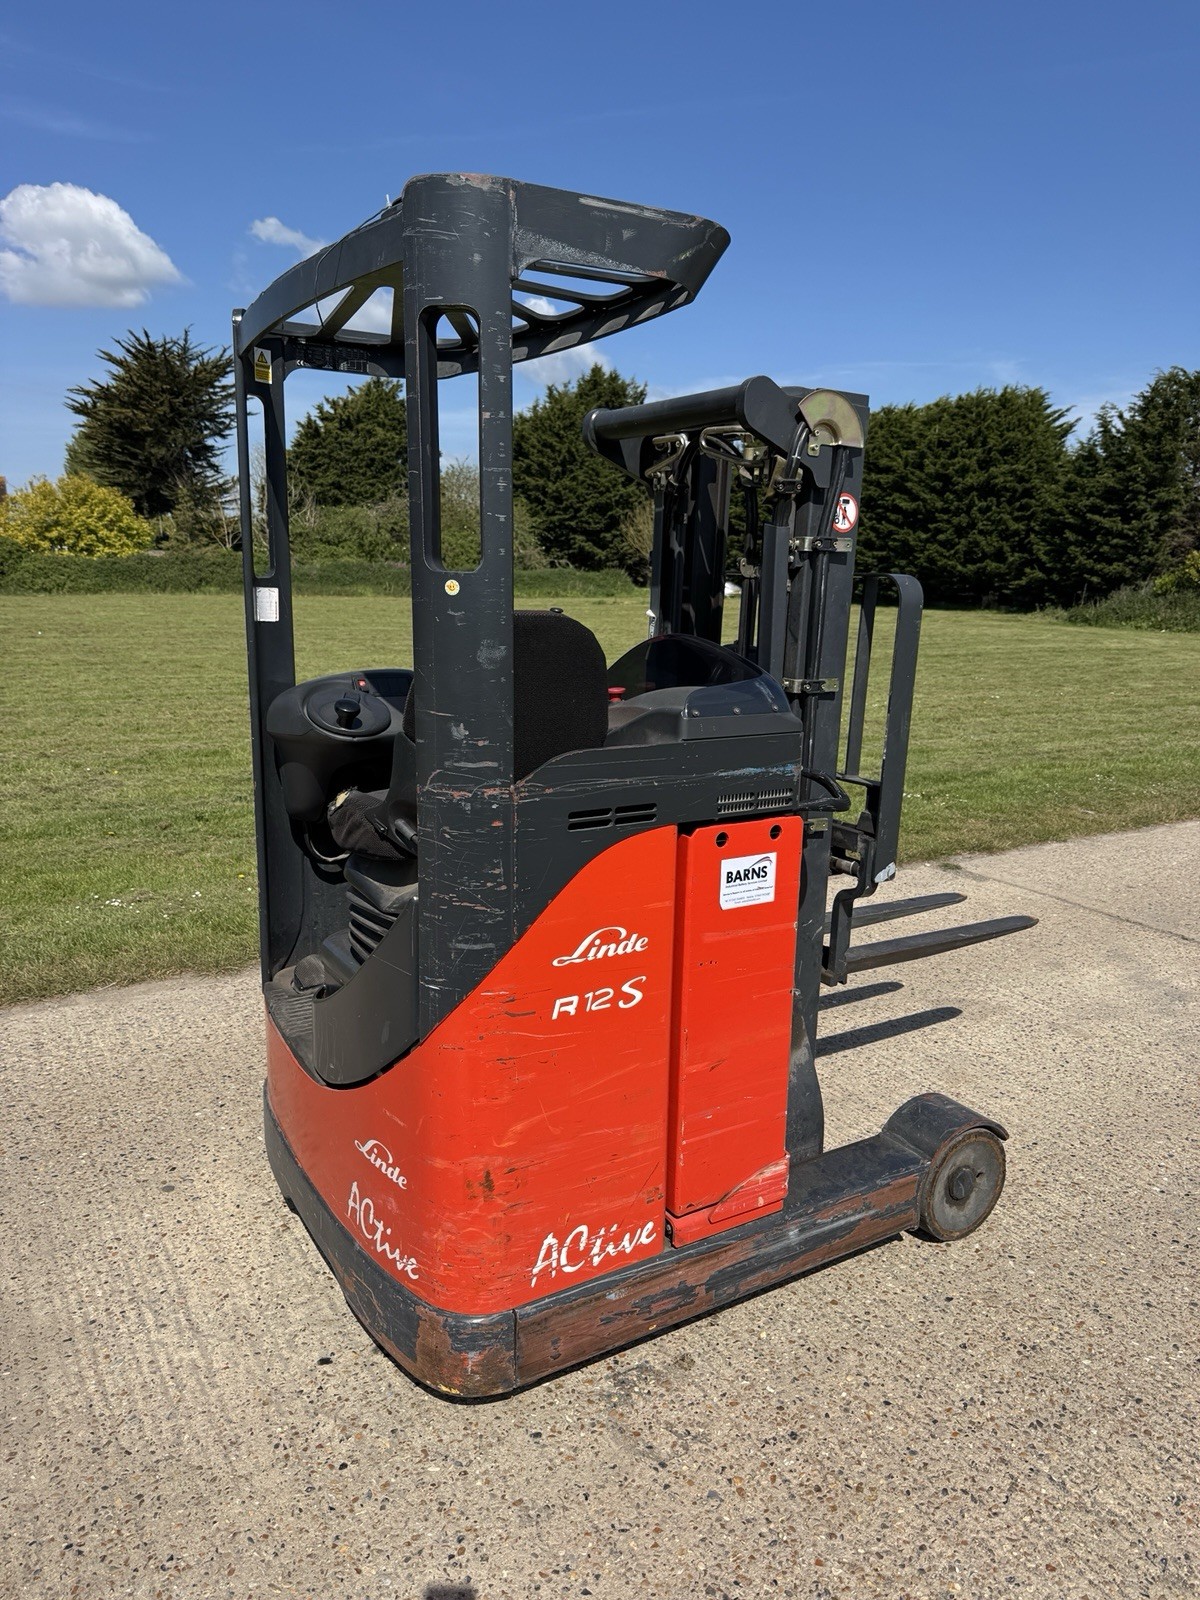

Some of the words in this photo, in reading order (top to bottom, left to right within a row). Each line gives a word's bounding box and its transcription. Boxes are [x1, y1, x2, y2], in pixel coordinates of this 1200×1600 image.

[726, 866, 768, 884] BARNS
[552, 926, 648, 967] Linde
[354, 1139, 408, 1190] Linde
